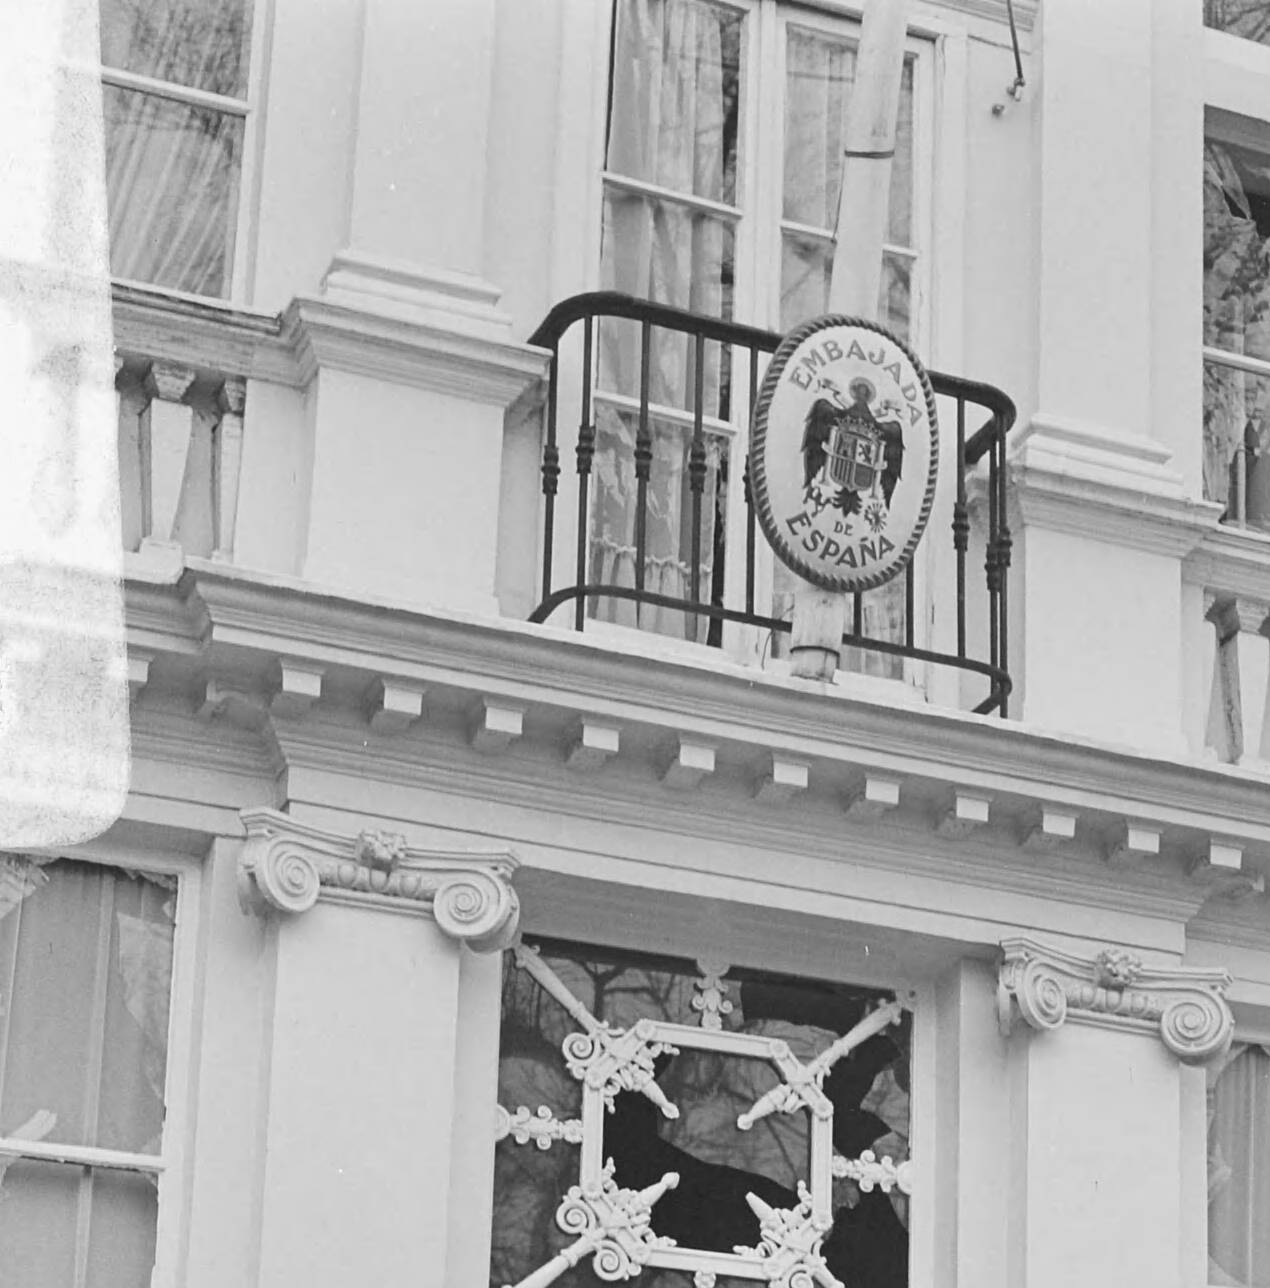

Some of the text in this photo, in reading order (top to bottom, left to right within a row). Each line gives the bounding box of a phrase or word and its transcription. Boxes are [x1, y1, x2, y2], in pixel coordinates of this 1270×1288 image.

[789, 338, 923, 427] EMBAJADA
[785, 511, 896, 569] ESPAÑA
[833, 520, 854, 537] DE
